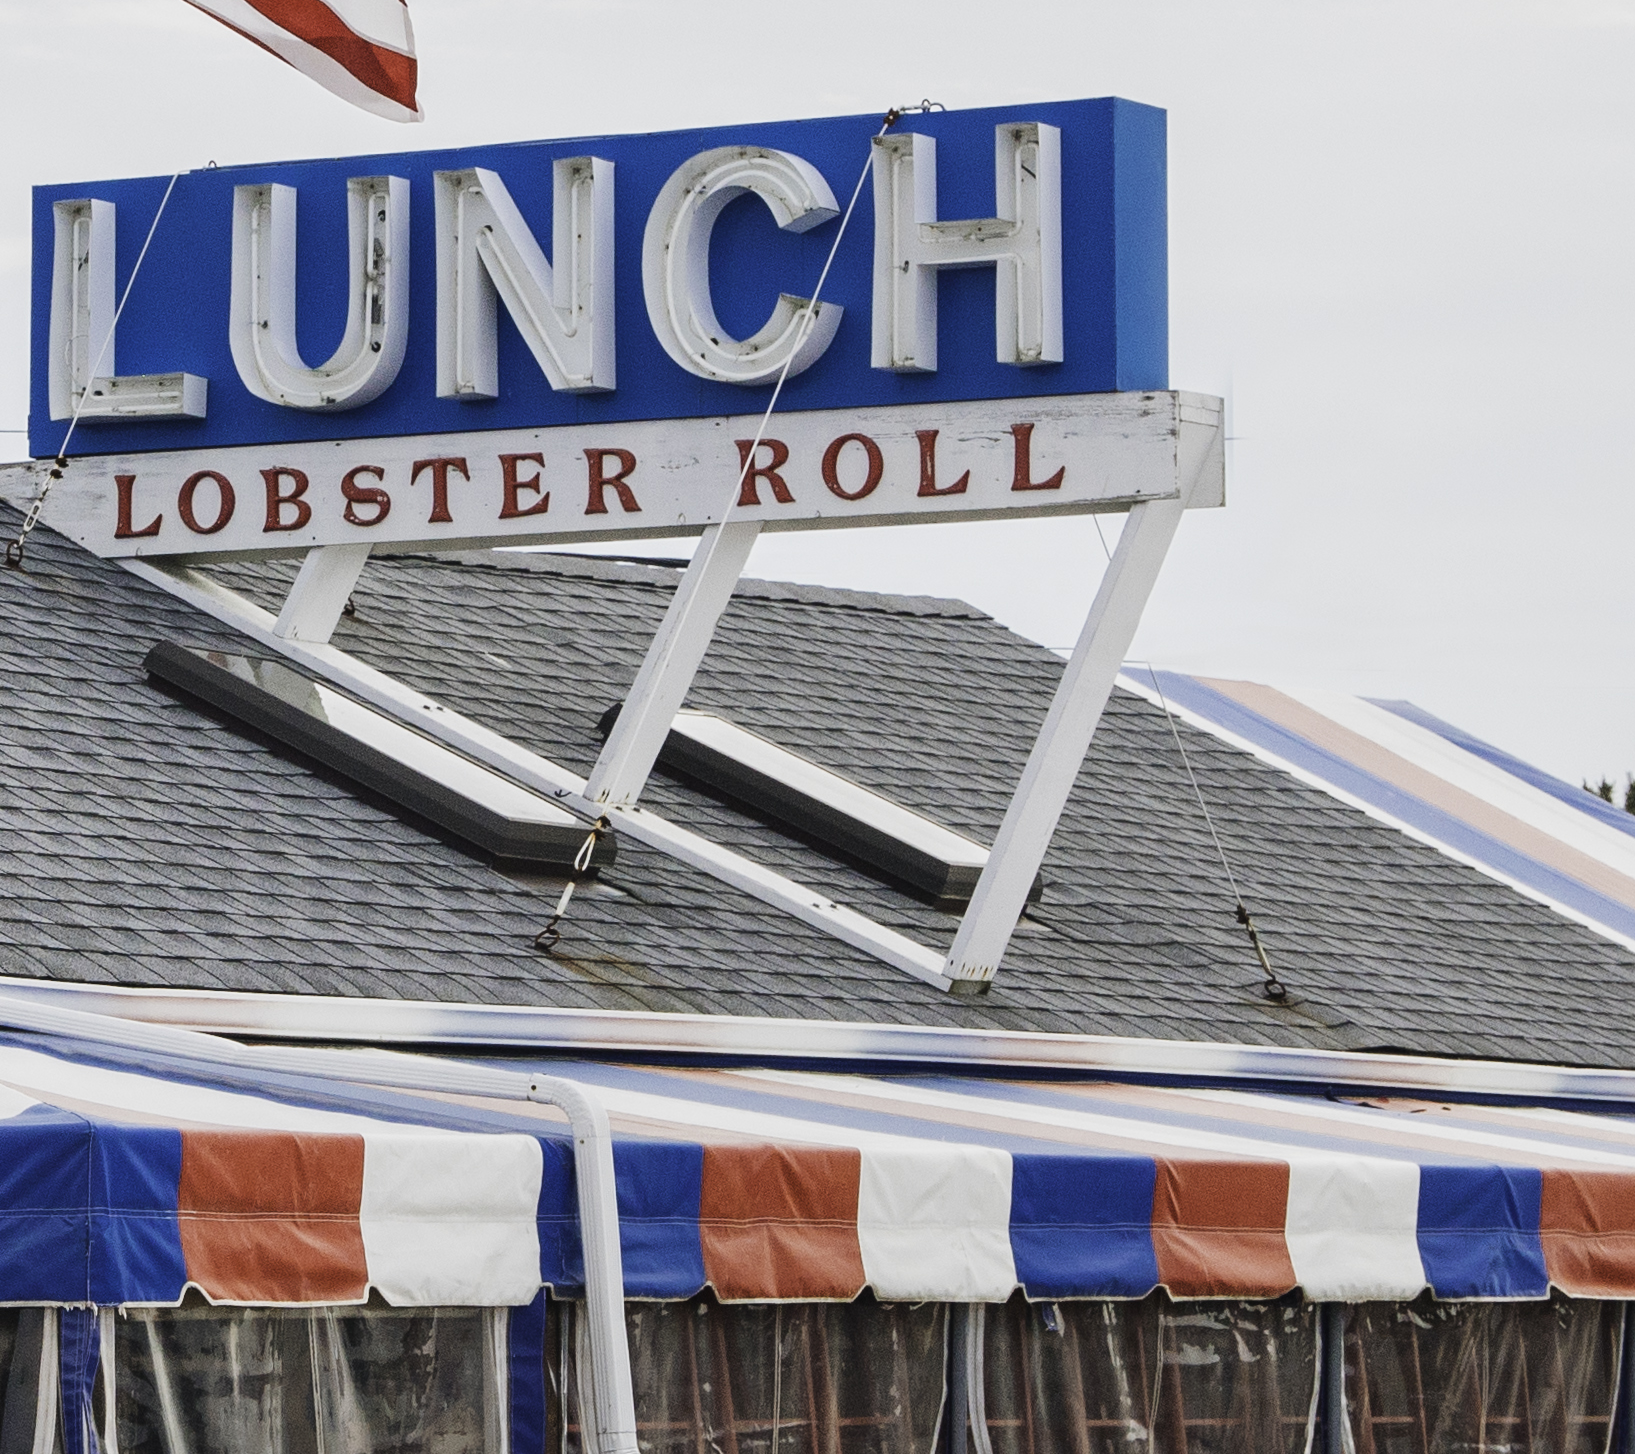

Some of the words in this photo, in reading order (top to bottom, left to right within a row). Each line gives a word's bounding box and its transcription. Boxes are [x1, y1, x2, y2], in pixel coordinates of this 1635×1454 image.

[48, 119, 1063, 421] LUNCH
[113, 447, 643, 540] LOBSTER
[734, 422, 1066, 507] ROLL
